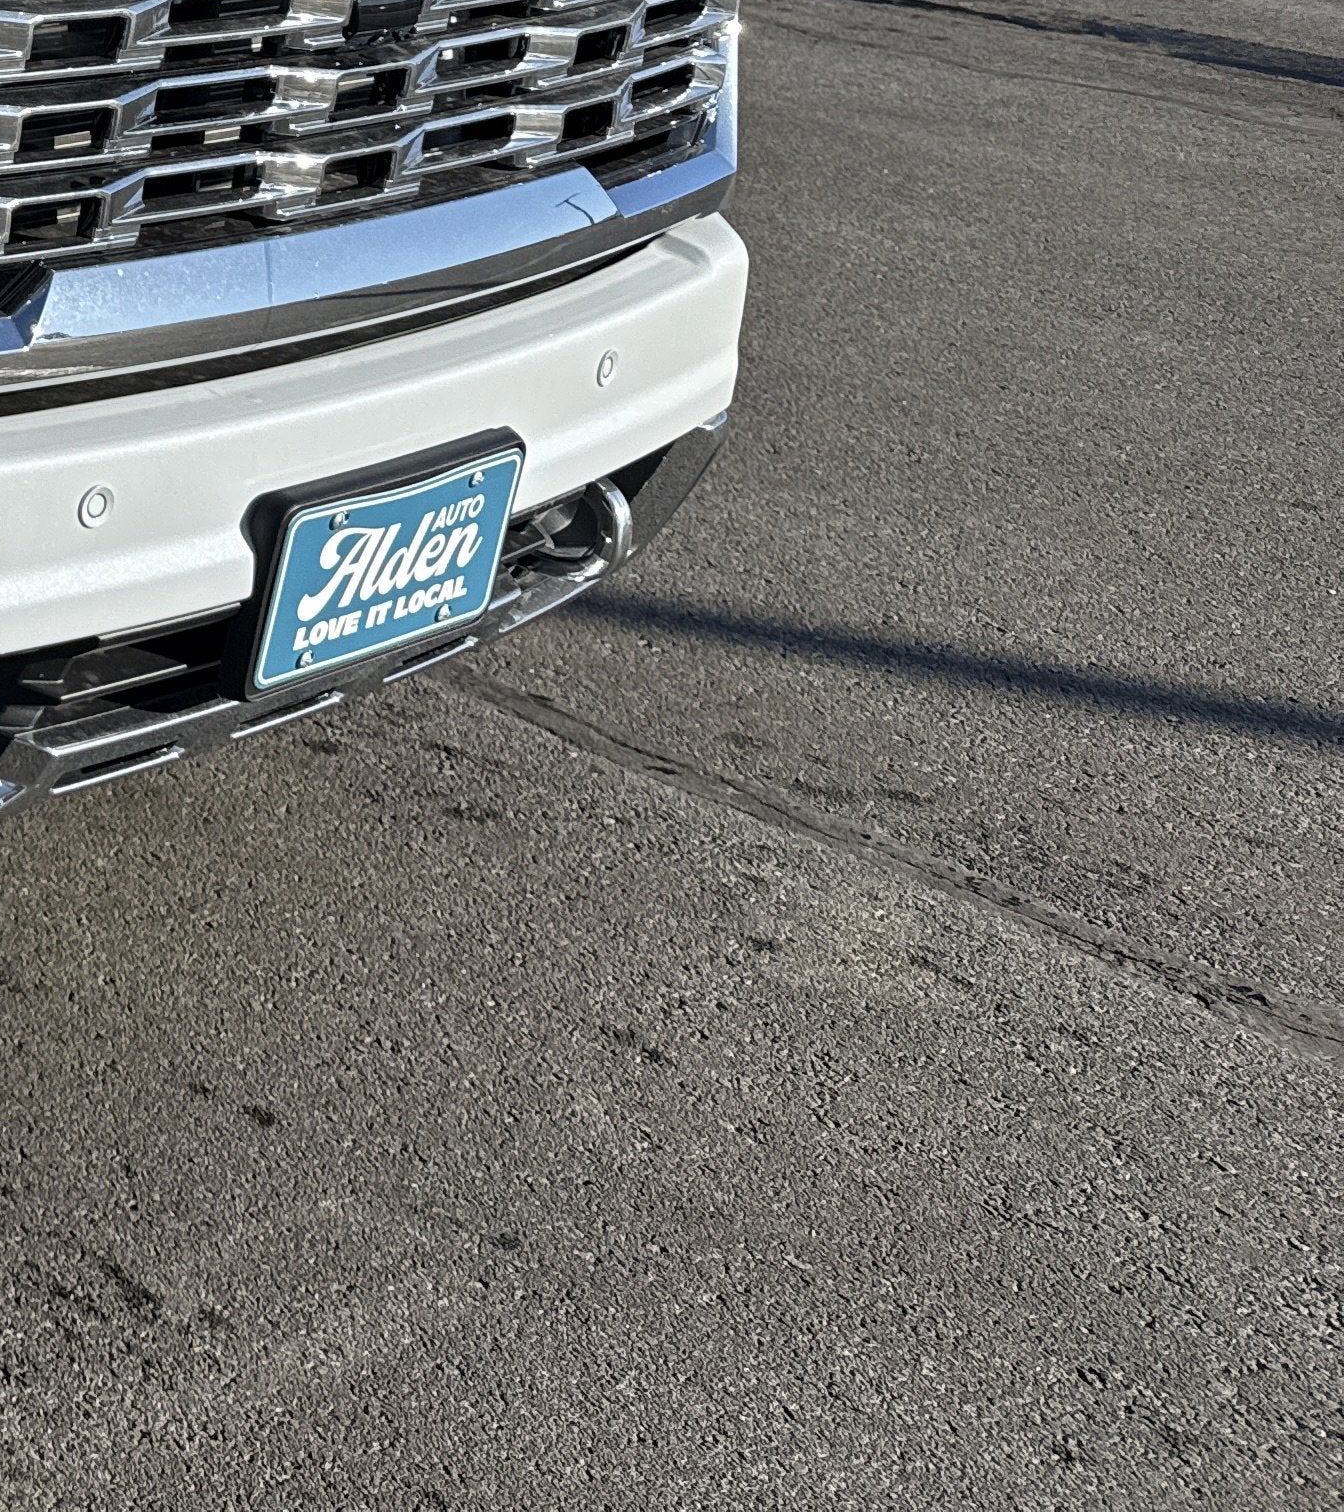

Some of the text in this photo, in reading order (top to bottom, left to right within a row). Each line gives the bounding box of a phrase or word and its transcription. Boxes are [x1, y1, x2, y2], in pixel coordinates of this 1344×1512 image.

[432, 493, 486, 532] AUTO
[297, 511, 483, 622] Alden
[292, 576, 468, 651] LOVE IT LOCAL
